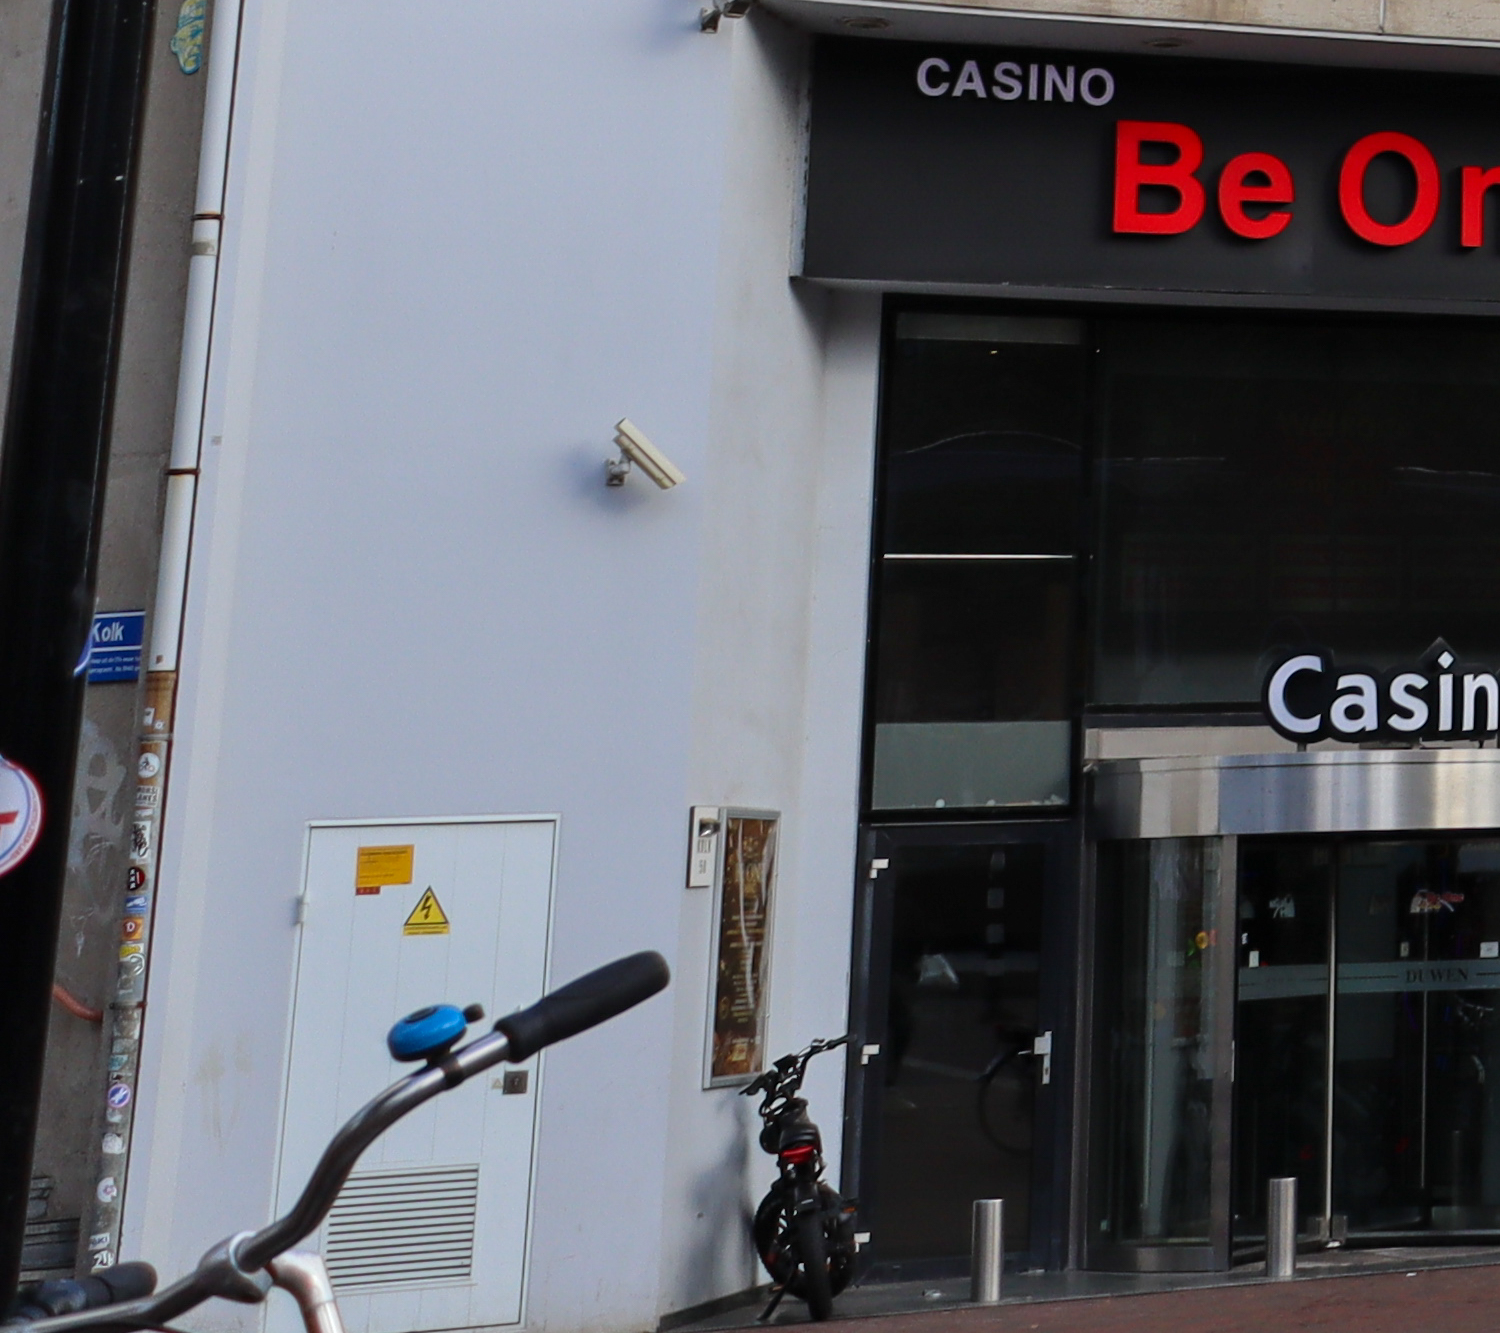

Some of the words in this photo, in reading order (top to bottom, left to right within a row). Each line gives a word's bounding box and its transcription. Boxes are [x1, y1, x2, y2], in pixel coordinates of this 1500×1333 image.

[916, 56, 1115, 107] CASINO
[1112, 119, 1296, 240] Be
[1406, 967, 1470, 983] DUWEN
